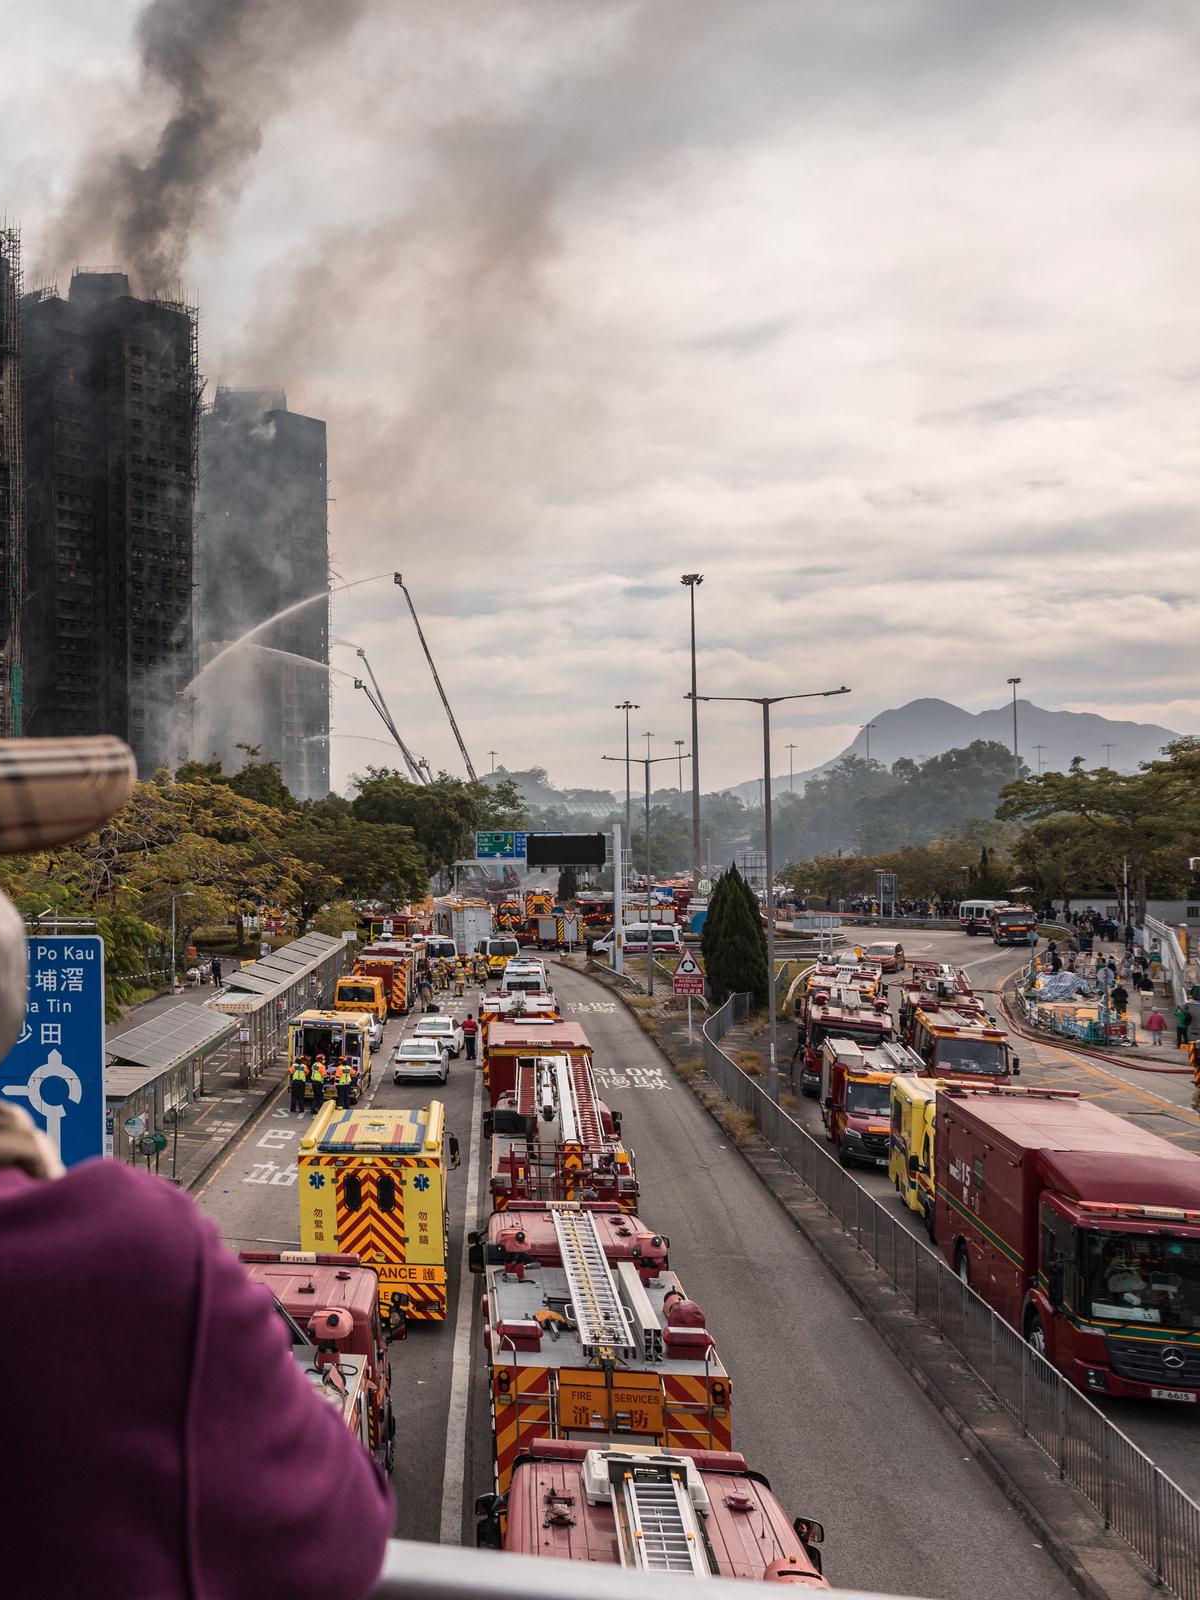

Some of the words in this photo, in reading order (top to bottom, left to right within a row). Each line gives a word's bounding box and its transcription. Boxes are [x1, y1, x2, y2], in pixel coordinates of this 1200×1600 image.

[37, 946, 58, 960] Po
[63, 946, 95, 960] Kau
[26, 967, 84, 992] 埔滘
[46, 999, 72, 1013] Tin
[592, 1067, 663, 1076] SLOW
[962, 1161, 971, 1187] 15
[571, 1391, 592, 1401] FIRE
[614, 1393, 660, 1405] SERVICES
[1157, 1390, 1164, 1398] F
[1167, 1391, 1190, 1401] 6615
[572, 1405, 591, 1425] 消
[629, 1409, 649, 1429] 防
